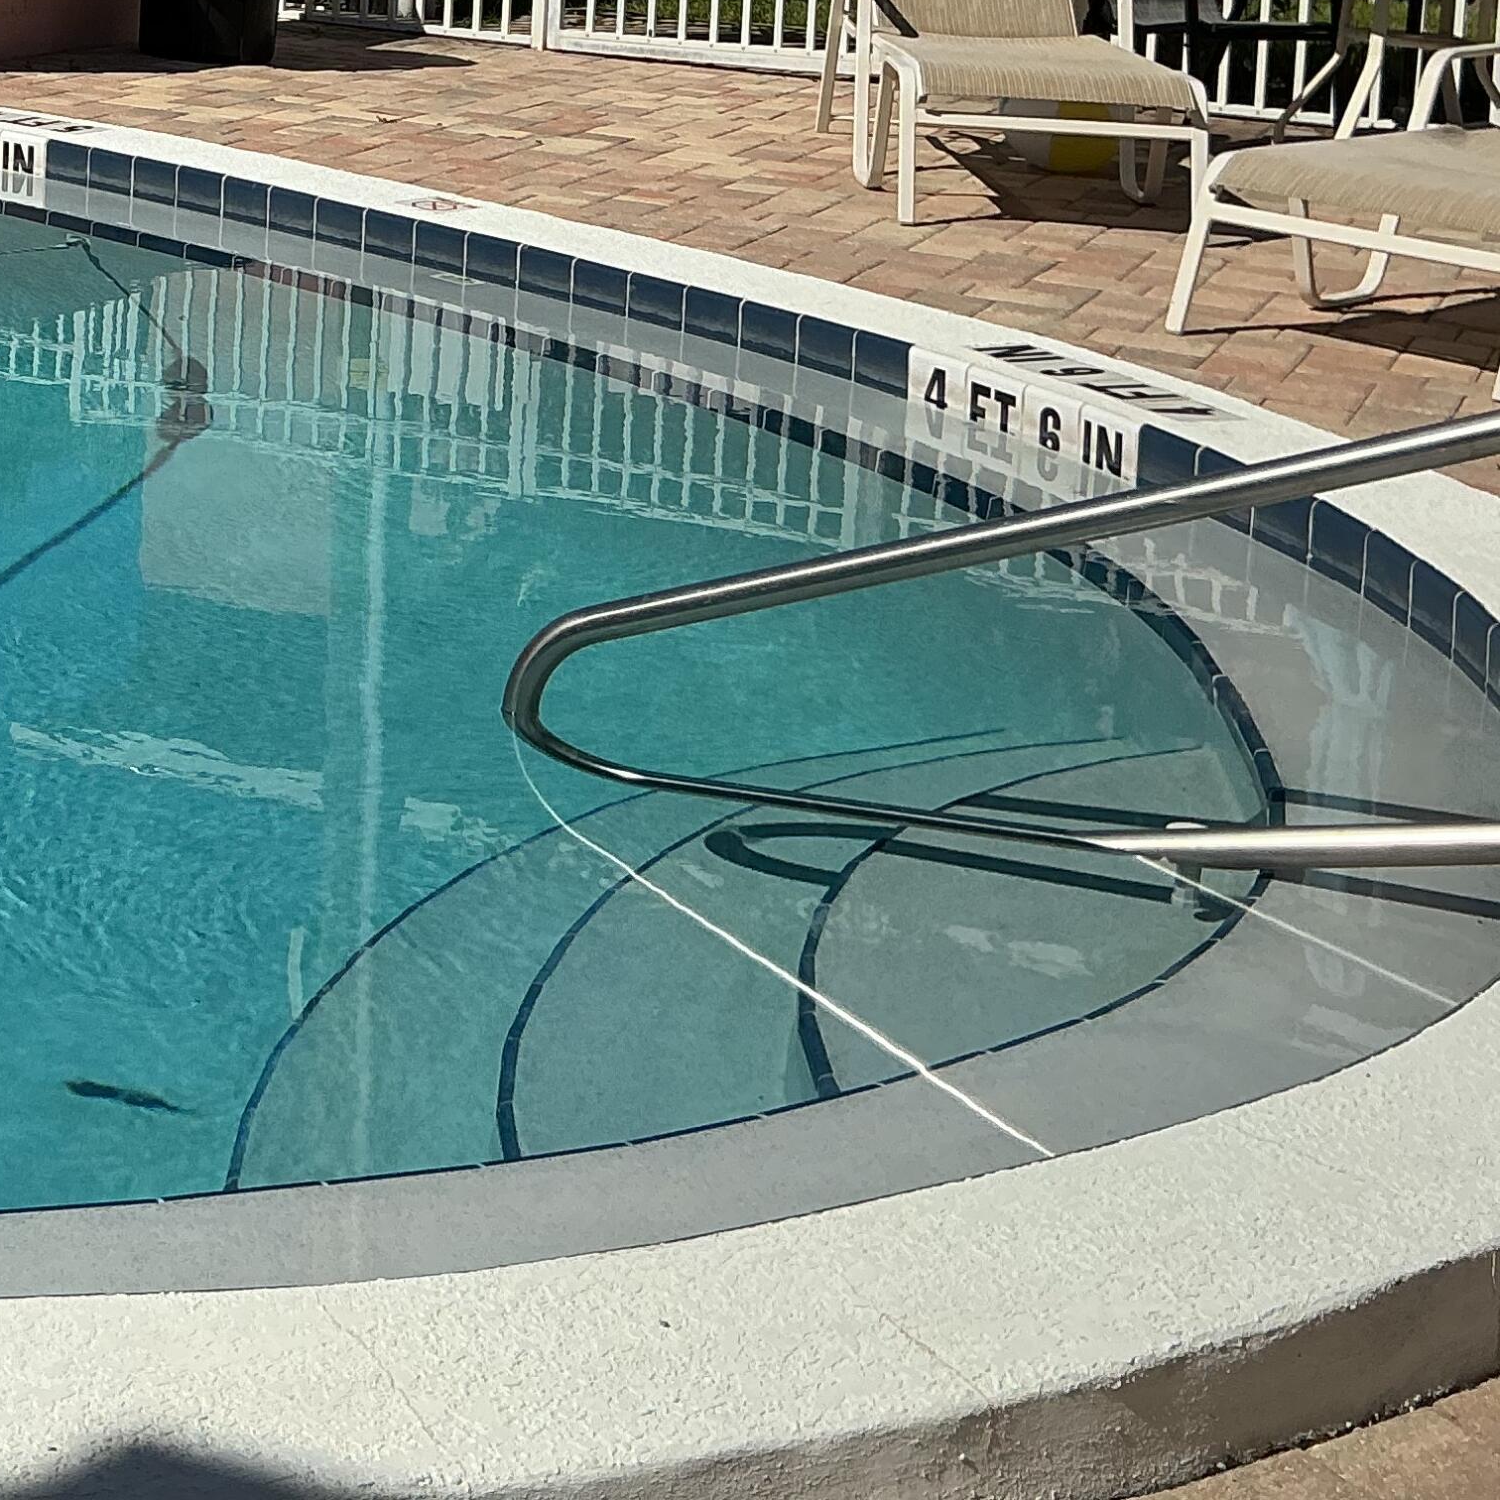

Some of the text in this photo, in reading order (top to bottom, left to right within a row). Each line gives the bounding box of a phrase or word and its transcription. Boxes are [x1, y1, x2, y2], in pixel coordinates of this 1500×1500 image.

[2, 140, 35, 174] IN
[924, 367, 1123, 478] 4 FT 6 IN
